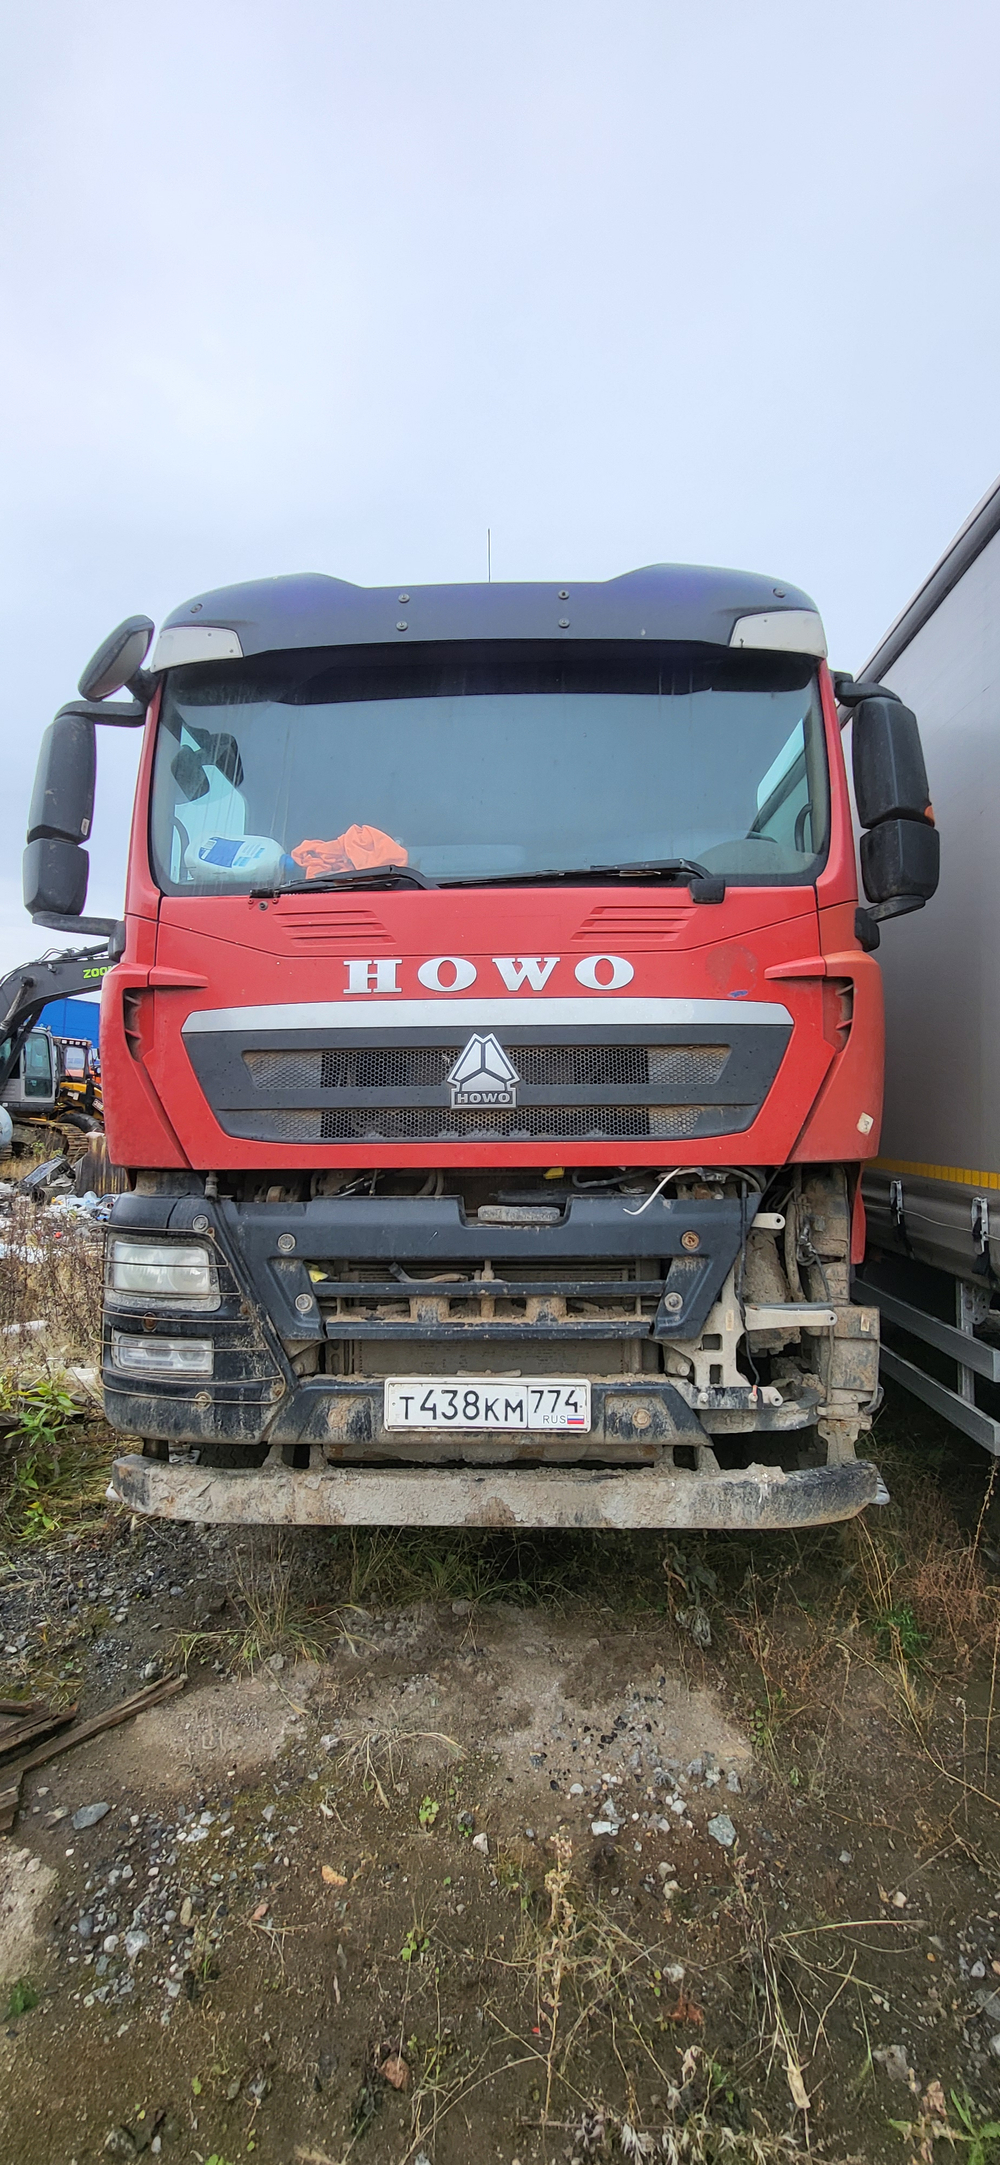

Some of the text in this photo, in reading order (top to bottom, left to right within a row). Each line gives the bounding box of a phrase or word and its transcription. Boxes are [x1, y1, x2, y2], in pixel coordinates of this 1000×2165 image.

[83, 966, 112, 979] ZOO
[343, 955, 635, 994] HOWO
[457, 1092, 510, 1104] HOWO
[530, 1389, 579, 1413] 774
[542, 1414, 566, 1424] RUS
